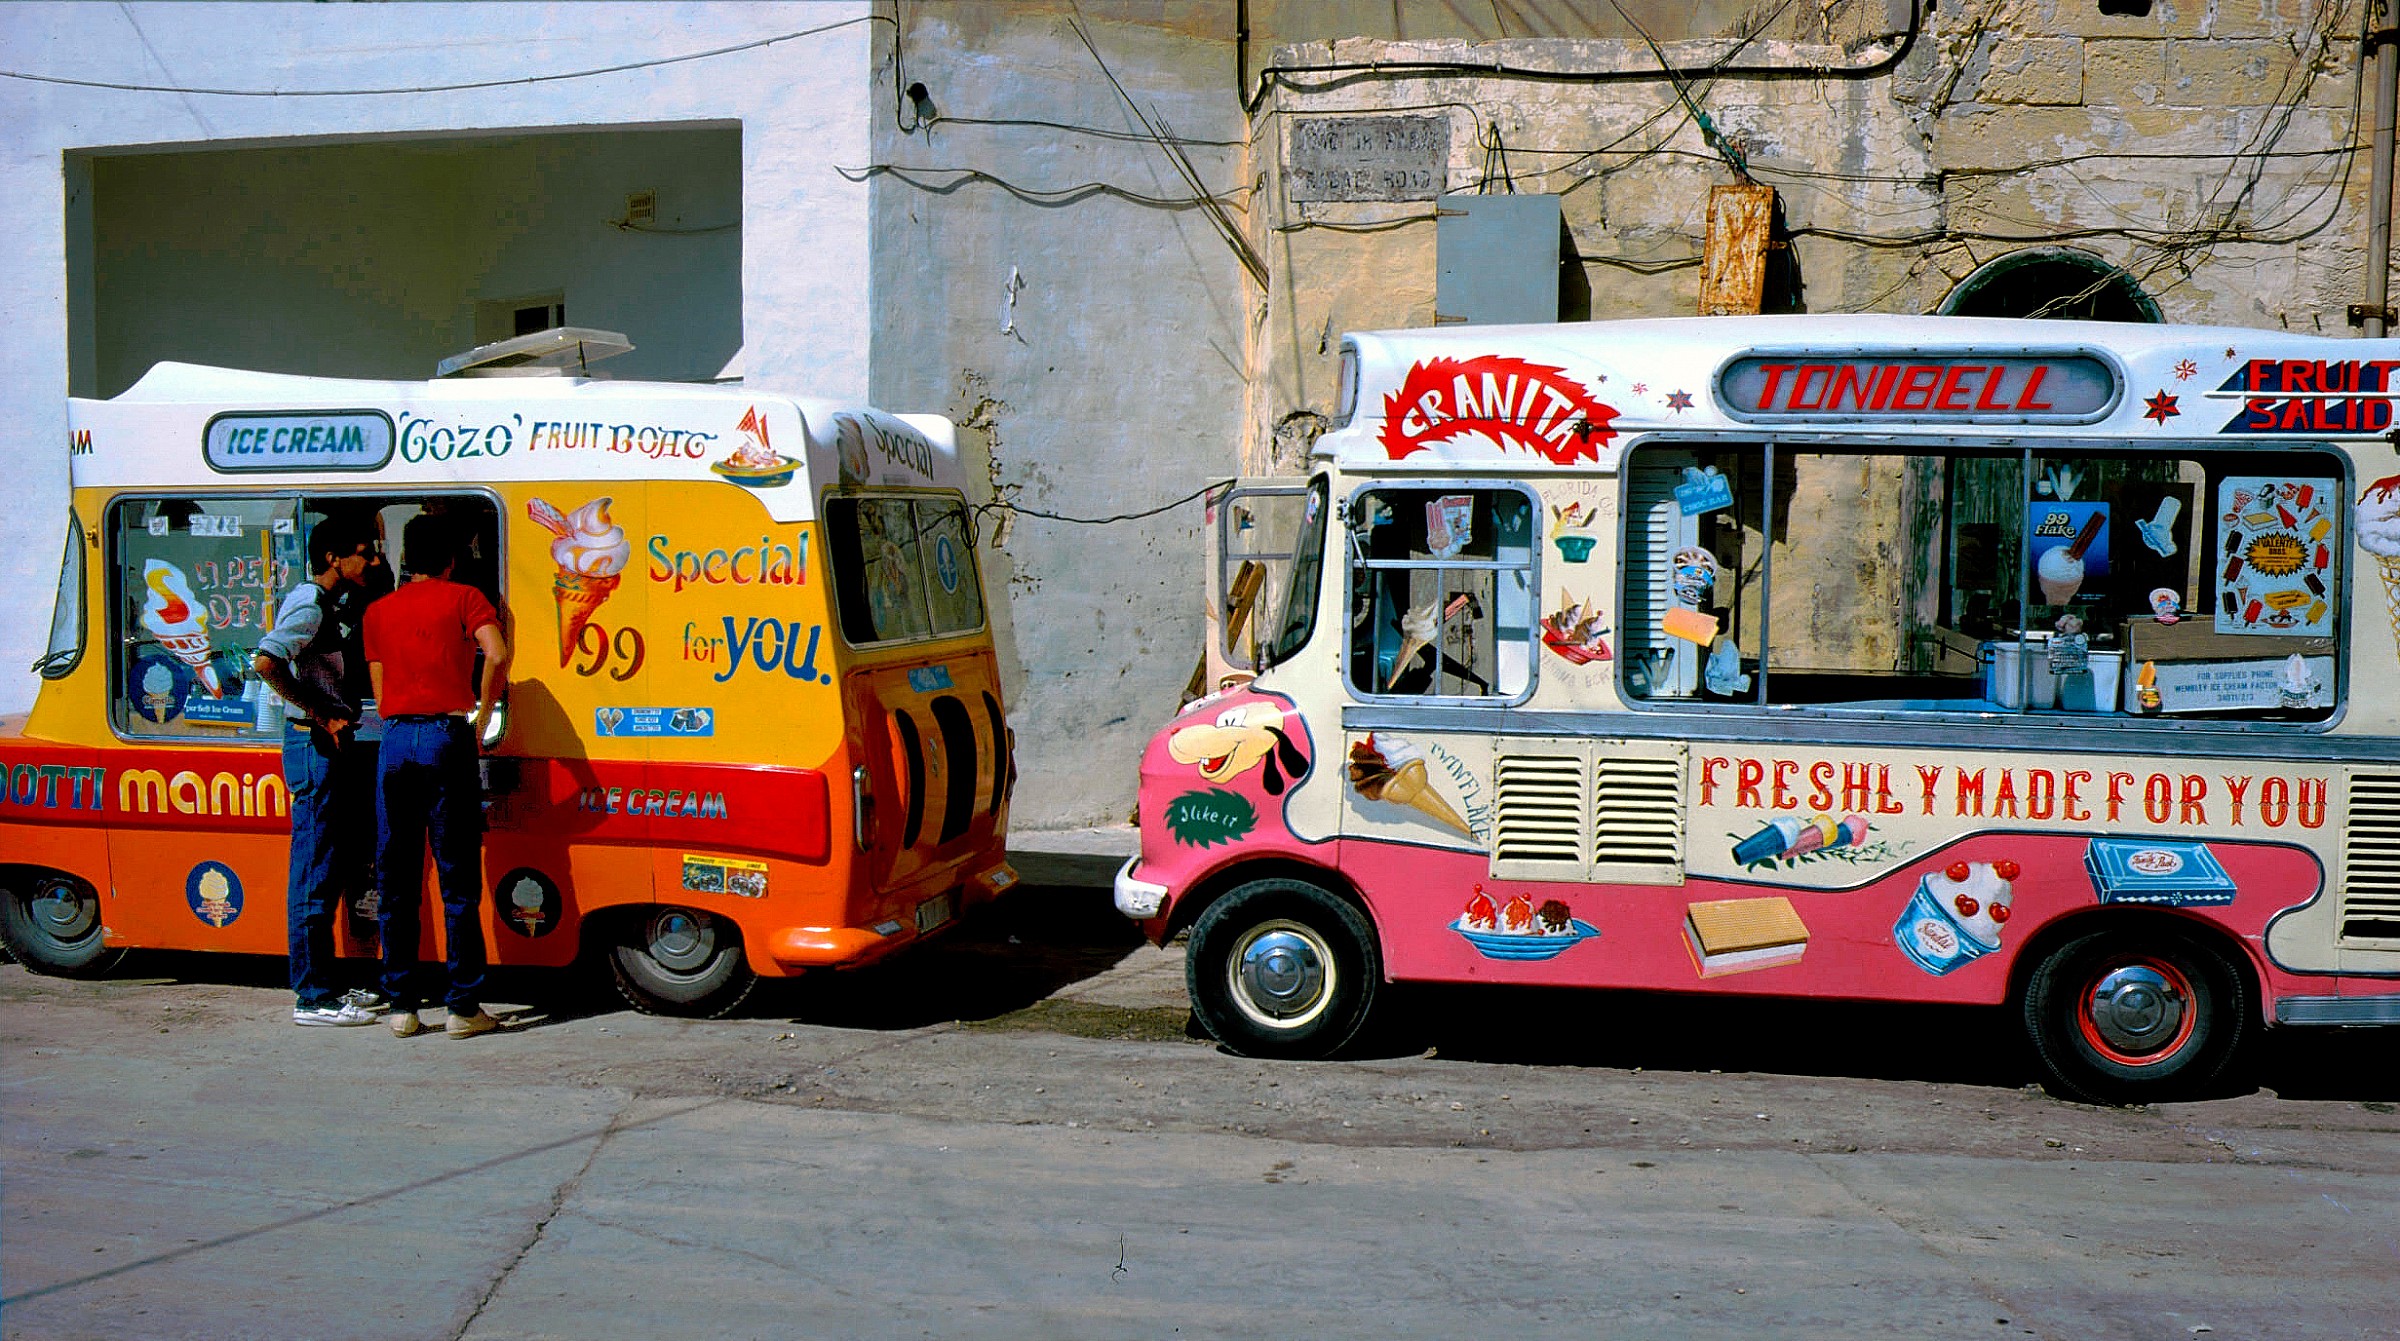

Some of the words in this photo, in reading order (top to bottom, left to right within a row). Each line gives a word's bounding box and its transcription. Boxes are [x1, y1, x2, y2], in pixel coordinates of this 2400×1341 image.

[1757, 364, 2053, 411] TONIBELL
[2247, 359, 2400, 393] FRUIT
[2246, 397, 2394, 431] SALID
[227, 428, 268, 455] ICE
[272, 426, 365, 454] CREAM
[529, 421, 604, 452] FRUIT
[607, 423, 719, 460] BOAT
[862, 413, 935, 482] Special
[2044, 512, 2070, 526] 99
[649, 530, 810, 594] Special
[576, 622, 645, 682] 99
[683, 622, 723, 663] for
[2197, 671, 2211, 681] FOR
[2251, 670, 2274, 679] PHONE
[578, 786, 621, 815] ICE
[627, 788, 728, 820] CREAM
[1700, 756, 1941, 816] FRESHLY
[1955, 765, 2092, 821] MADE
[2106, 770, 2208, 825] FOR
[2221, 774, 2330, 830] YOU
